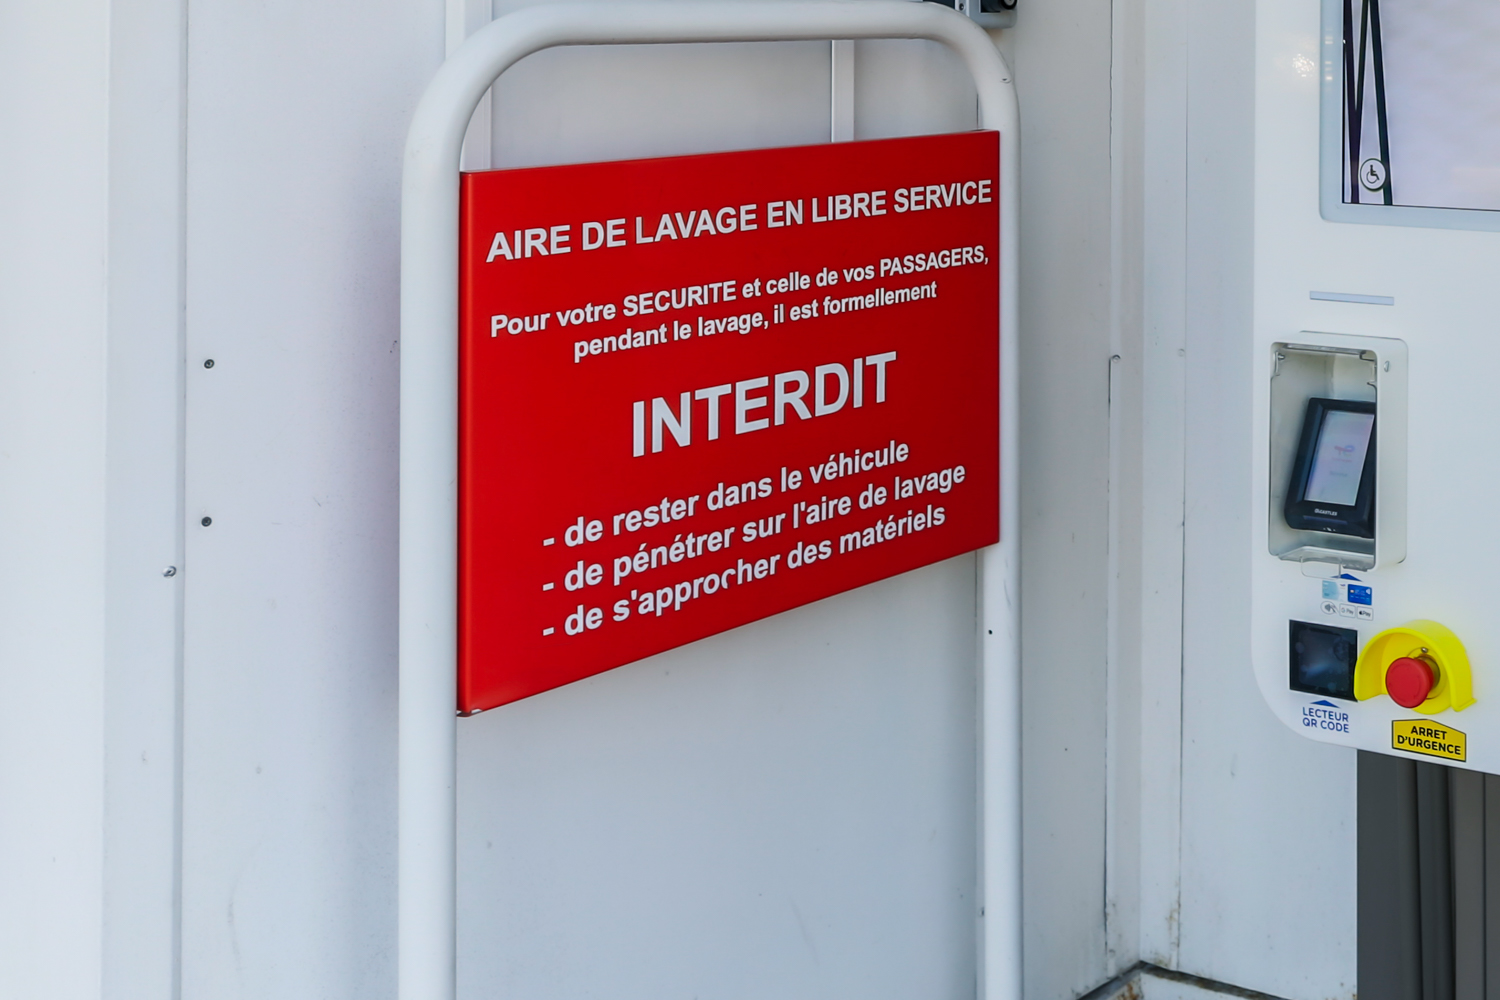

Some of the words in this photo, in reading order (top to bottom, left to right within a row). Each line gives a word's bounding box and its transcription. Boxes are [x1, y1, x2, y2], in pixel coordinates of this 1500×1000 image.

[485, 224, 571, 263] AIRE
[582, 218, 626, 251] DE
[635, 203, 758, 245] LAVAGE
[767, 199, 803, 229] EN
[812, 190, 887, 223] LIBRE
[893, 179, 992, 213] SERVICE
[491, 312, 551, 338] Pour
[555, 302, 617, 327] votre
[622, 280, 737, 317] SECURITE
[742, 277, 762, 299] et
[765, 271, 811, 295] celle
[815, 267, 839, 287] de
[842, 265, 875, 283] vos
[880, 245, 989, 278] PASSAGERS,
[574, 323, 668, 364] pendant
[673, 320, 692, 341] le
[698, 312, 769, 337] lavage,
[773, 303, 785, 324] il
[789, 298, 819, 321] est
[822, 280, 937, 316] formellement
[632, 350, 897, 458] INTERDIT
[564, 516, 603, 547] de
[613, 494, 700, 536] rester
[707, 477, 772, 511] dans
[781, 466, 803, 493] le
[809, 439, 909, 484] véhicule
[564, 560, 603, 592] de
[613, 526, 736, 587] pénétrer
[742, 512, 786, 543] sur
[793, 495, 852, 529] l'aire
[858, 483, 887, 510] de
[894, 465, 966, 501] lavage
[564, 604, 603, 636] de
[787, 539, 832, 569] des
[839, 504, 946, 554] matériels
[1302, 706, 1349, 723] LECTEUR
[1302, 717, 1318, 728] QR
[1320, 719, 1350, 733] CODE
[1410, 725, 1447, 741] ARRET
